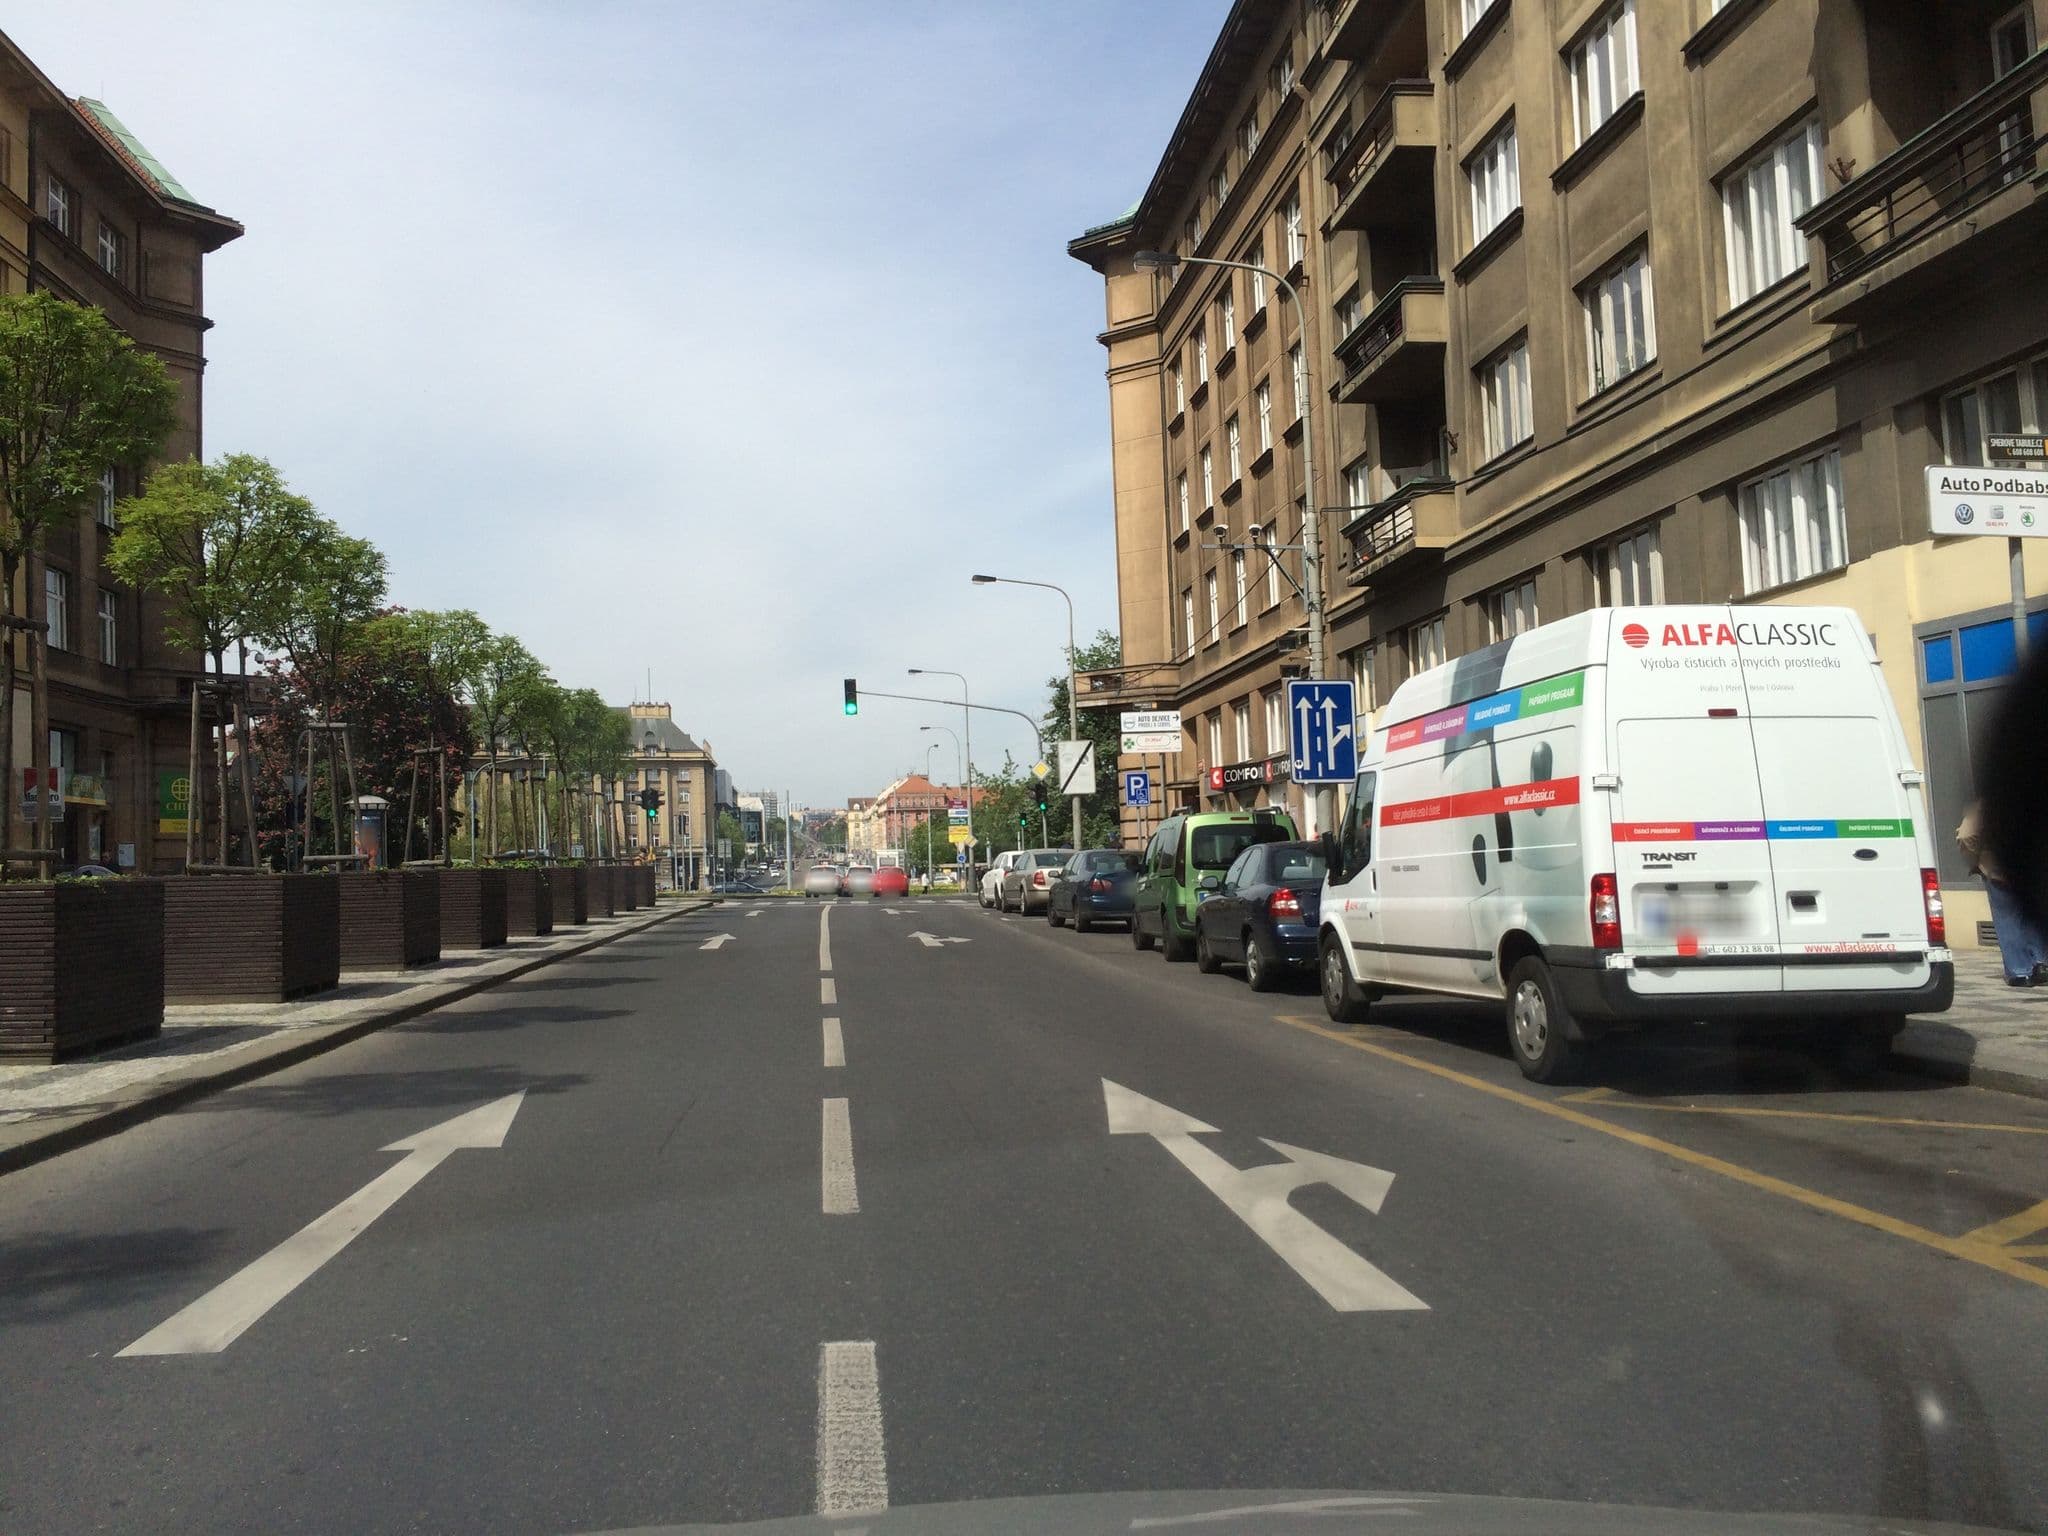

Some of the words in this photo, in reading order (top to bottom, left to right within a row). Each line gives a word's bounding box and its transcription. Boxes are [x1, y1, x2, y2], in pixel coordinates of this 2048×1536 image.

[1941, 477, 1980, 491] Auto
[1640, 657, 1680, 671] Výroba
[1731, 659, 1738, 668] a
[1152, 714, 1171, 722] DEJVICE
[1641, 852, 1698, 861] TRANSIT
[1722, 945, 1738, 953] 602
[1740, 945, 1750, 953] 32
[1752, 945, 1763, 953] 88
[1764, 944, 1775, 953] 08
[1804, 941, 1897, 954] www.alfaclassic.cz
